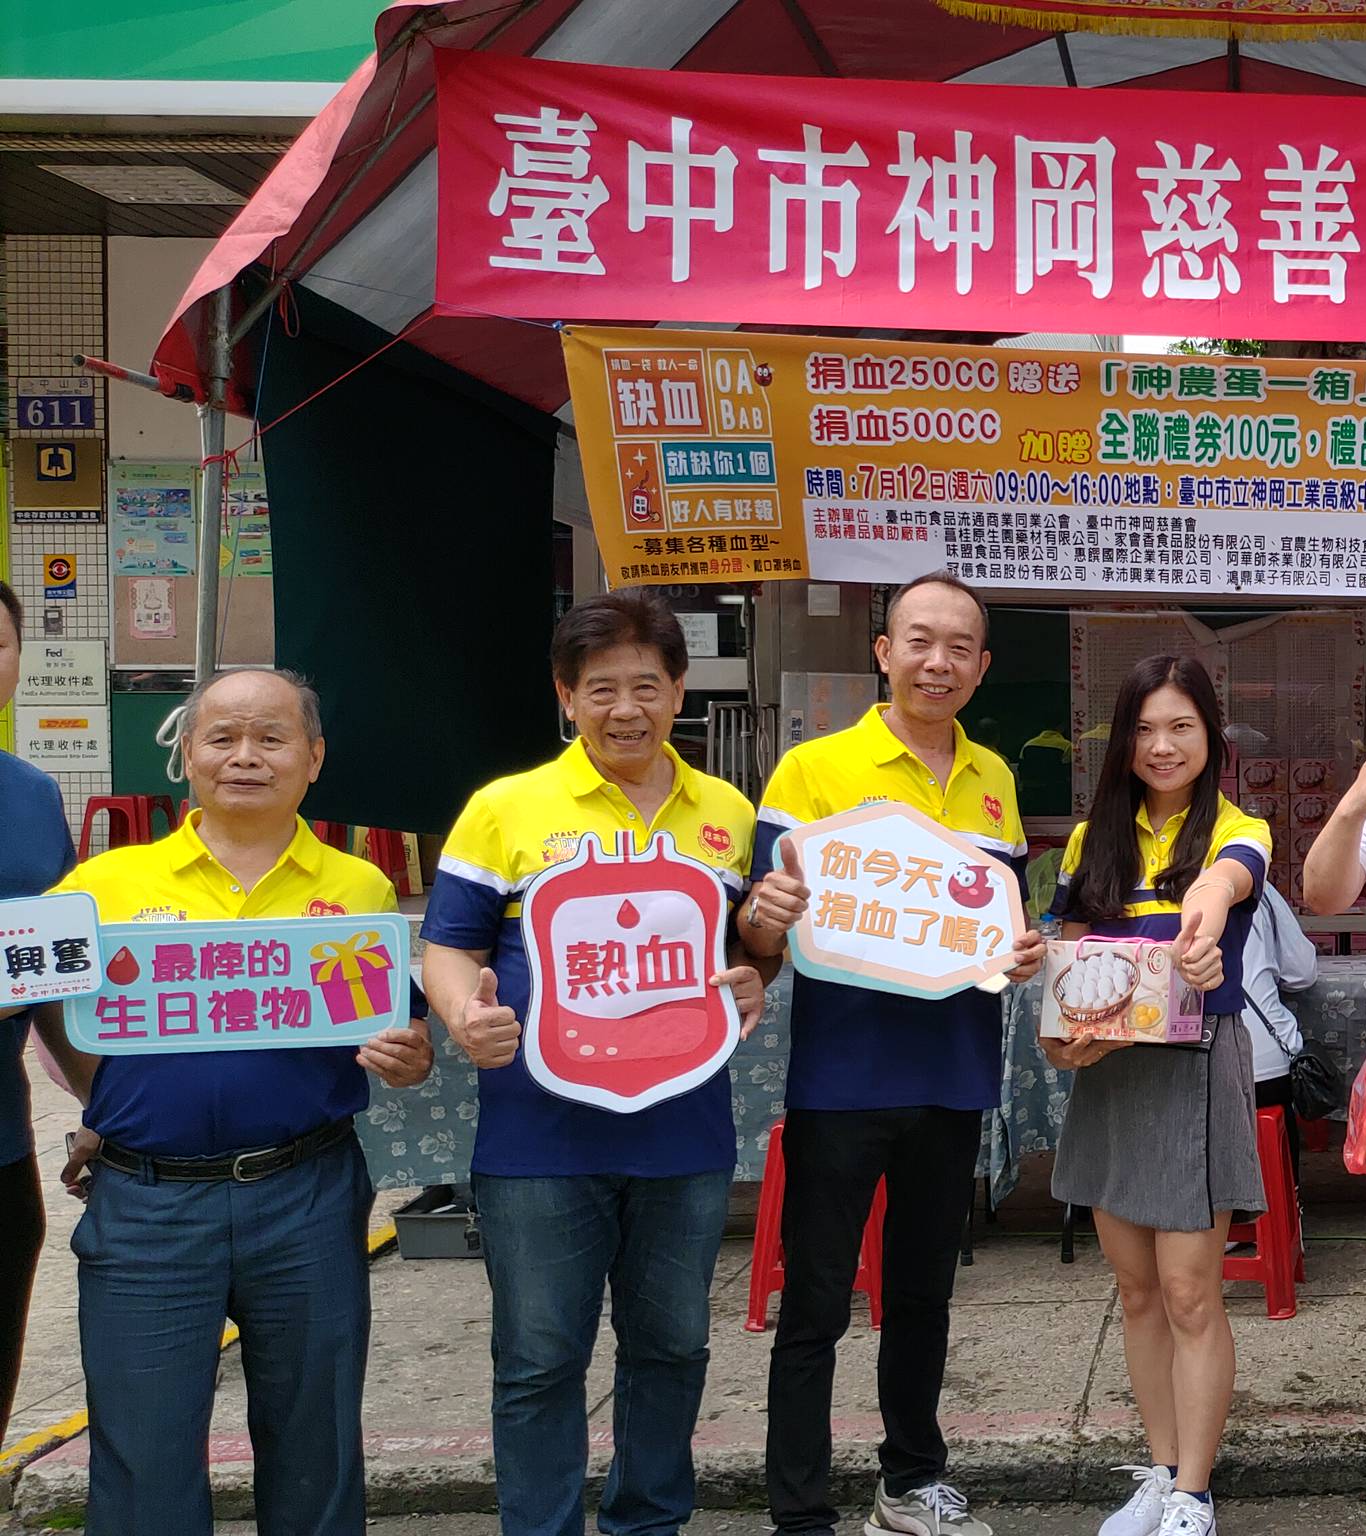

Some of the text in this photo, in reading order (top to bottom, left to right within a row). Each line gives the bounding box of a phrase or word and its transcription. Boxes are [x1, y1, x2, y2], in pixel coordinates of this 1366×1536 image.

[809, 356, 1080, 394] 捐血250CC 贈送
[27, 399, 85, 426] 611
[617, 378, 702, 427] 缺血
[814, 409, 1091, 464] 捐血500CC 加贈
[666, 450, 770, 477] 就缺你1個
[671, 499, 774, 523] 好人有好報
[27, 675, 94, 688] 代理收件處
[29, 739, 98, 751] 代理收件處
[550, 830, 578, 839] ITALY
[820, 838, 943, 899] 你今天
[140, 905, 171, 914] ITALY
[813, 890, 1005, 957] 捐血了嗎?
[4, 937, 92, 980] 興奮
[151, 939, 291, 984] 最棒的
[566, 934, 699, 1000] 熱血
[95, 987, 312, 1040] 生日禮物
